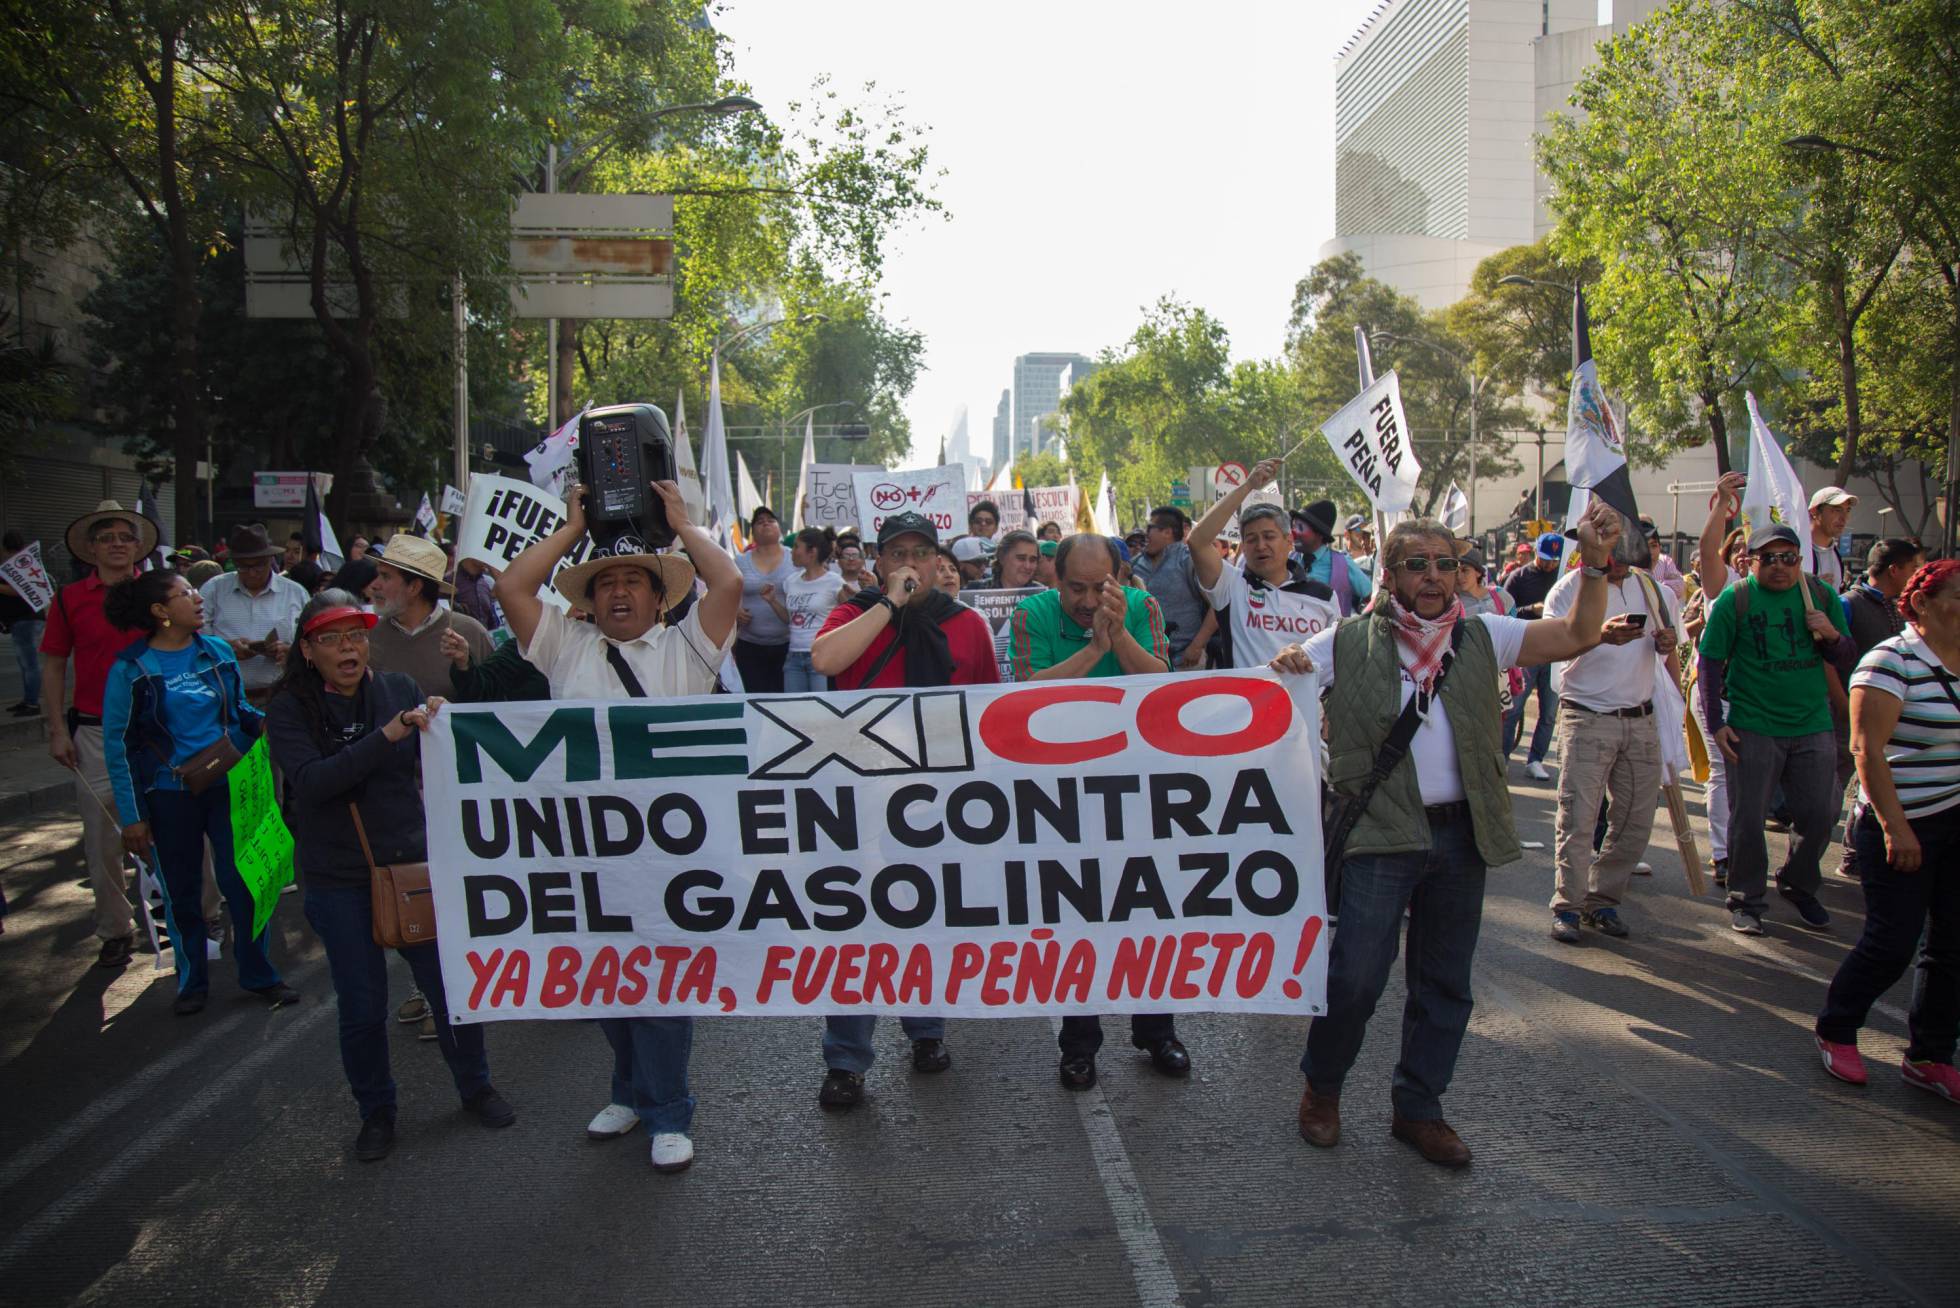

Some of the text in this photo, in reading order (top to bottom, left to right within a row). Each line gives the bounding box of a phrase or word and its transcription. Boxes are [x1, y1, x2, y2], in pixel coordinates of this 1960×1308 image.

[1343, 428, 1382, 499] PEÑA
[1370, 393, 1403, 476] FUERA
[1246, 610, 1322, 634] MEXICO
[451, 676, 1293, 783] MEXICO
[461, 768, 1294, 859] UNIDO EN CONTRA
[463, 850, 1299, 938] DEL GASOLINAZO
[466, 946, 530, 1011] YA
[539, 945, 737, 1013] BASTA,
[756, 941, 932, 1006] FUERA
[945, 928, 1096, 1006] PEÑA
